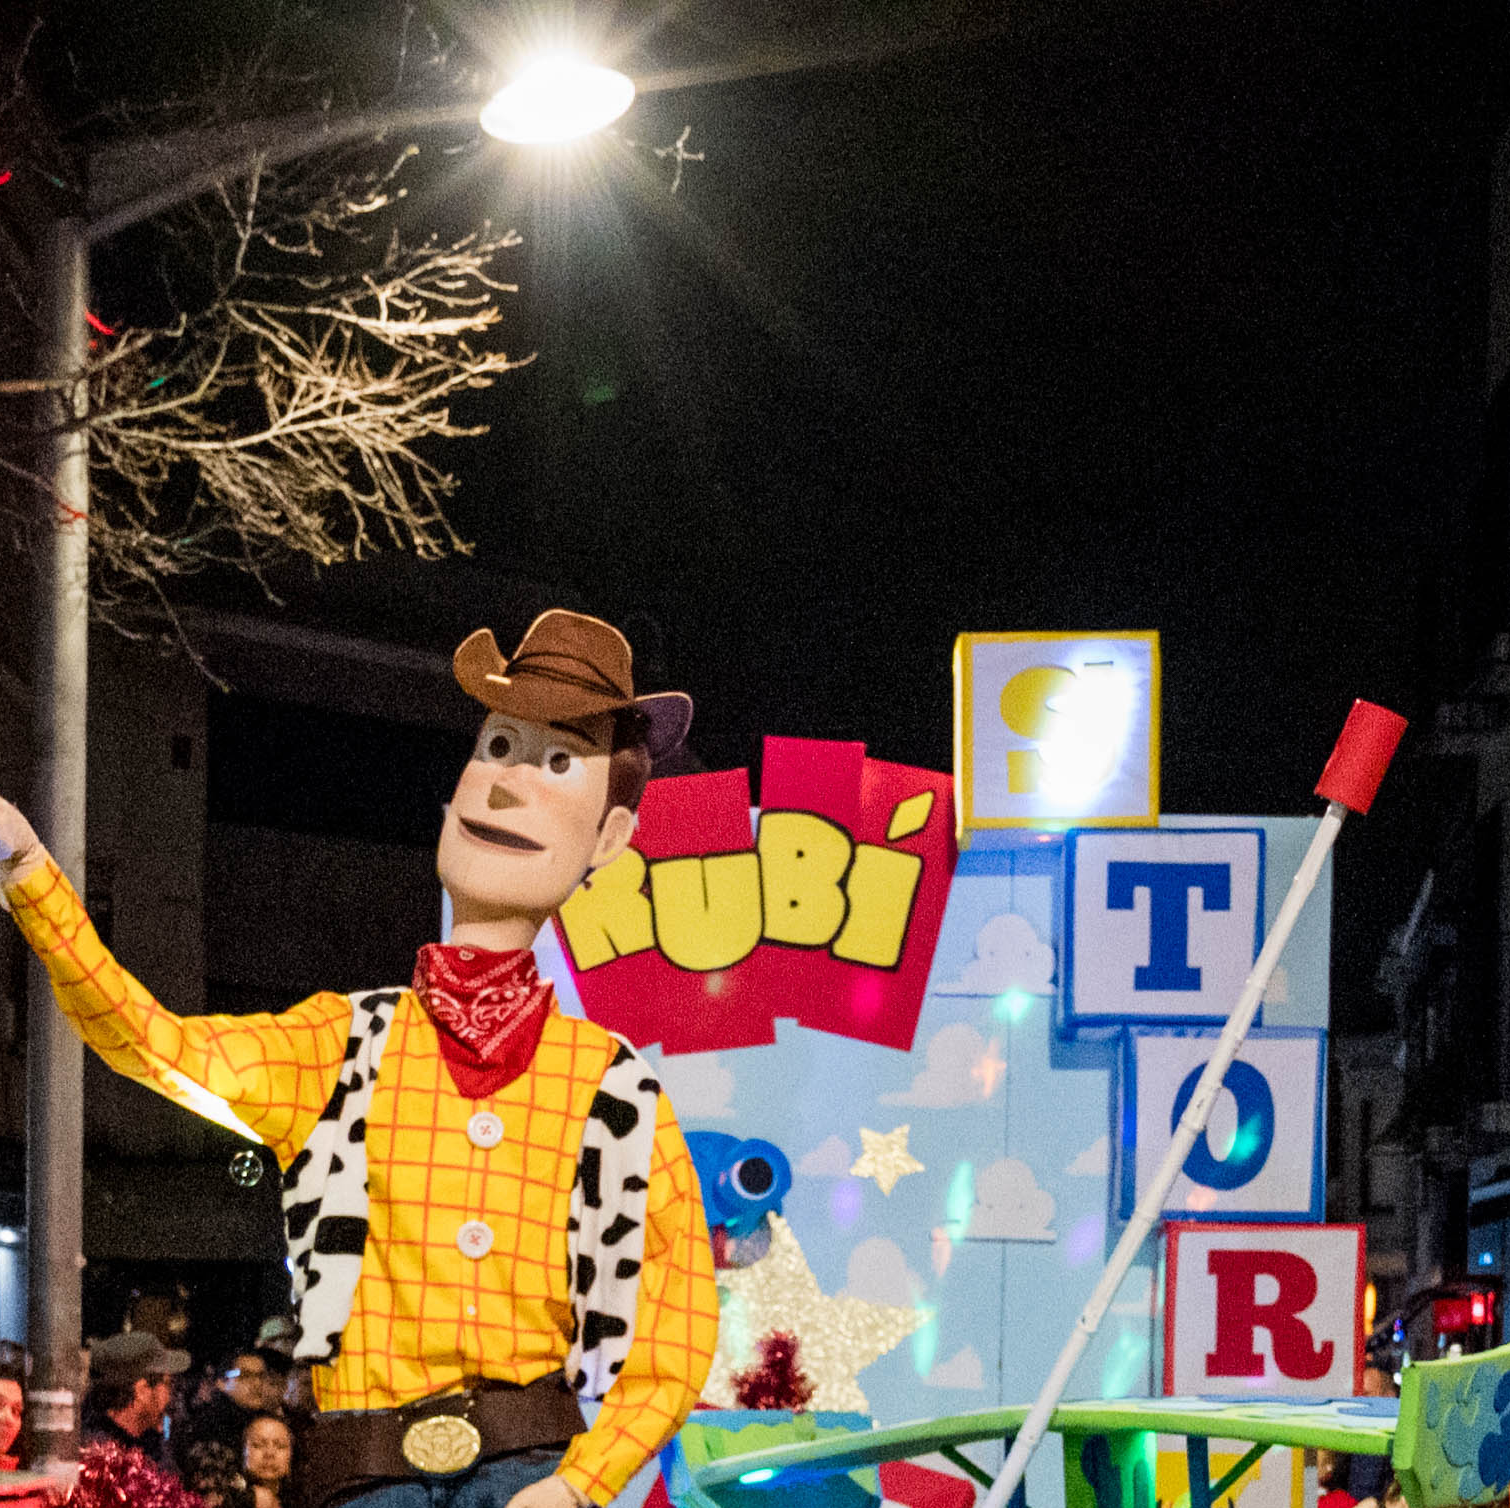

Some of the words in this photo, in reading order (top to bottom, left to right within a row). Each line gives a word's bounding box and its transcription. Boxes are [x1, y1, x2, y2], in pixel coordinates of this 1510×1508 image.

[1107, 861, 1231, 991] T
[1170, 1058, 1275, 1191] O
[1205, 1249, 1334, 1380] R
